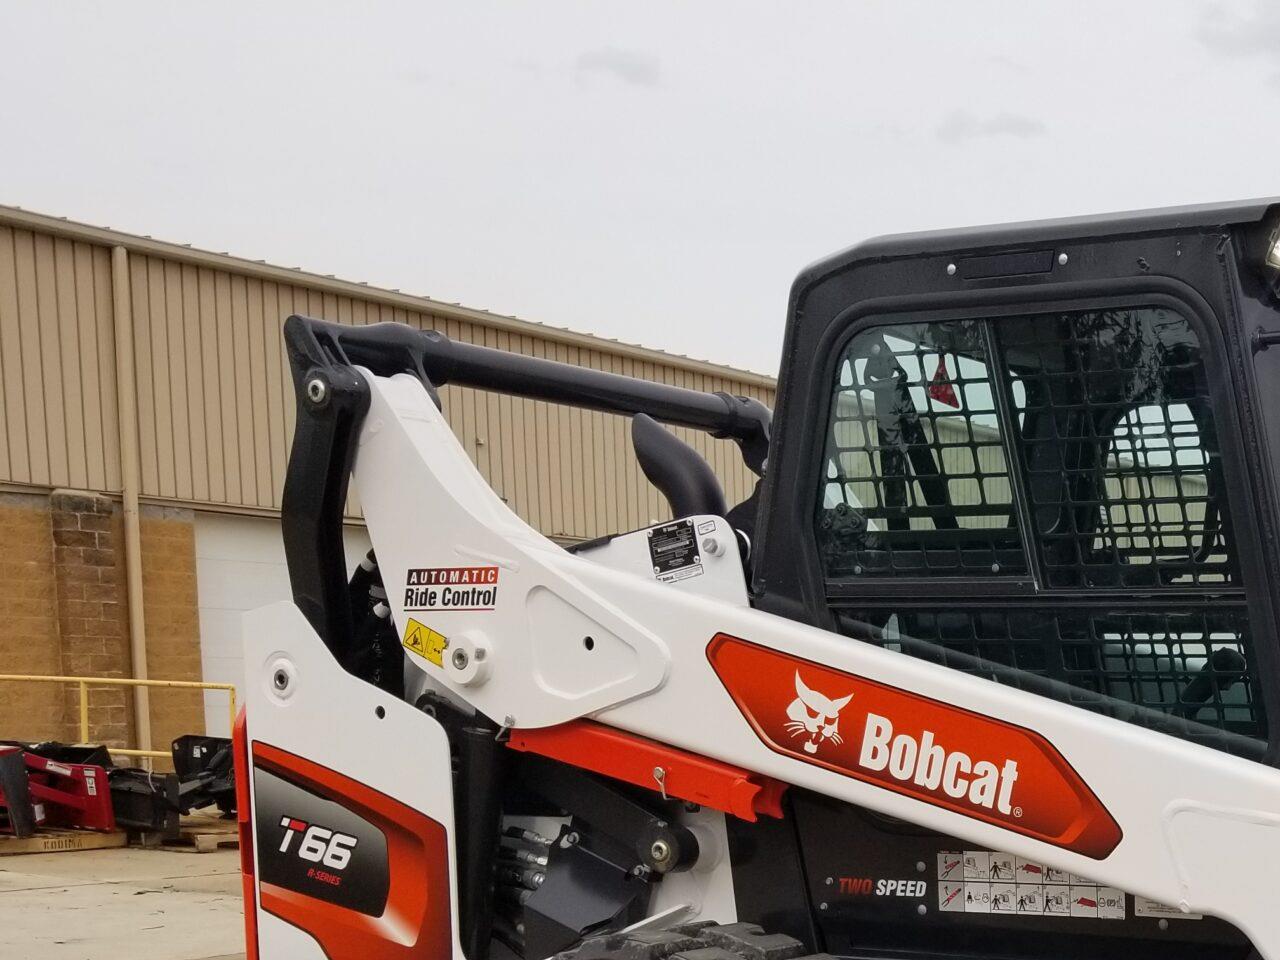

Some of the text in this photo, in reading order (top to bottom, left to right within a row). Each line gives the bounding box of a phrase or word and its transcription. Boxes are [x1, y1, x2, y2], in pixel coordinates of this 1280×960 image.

[410, 570, 495, 584] AUTOMATIC
[403, 586, 497, 607] Ride Control
[279, 817, 358, 870] T66
[306, 867, 342, 886] R-SERIES
[839, 877, 927, 897] TWO SPEED
